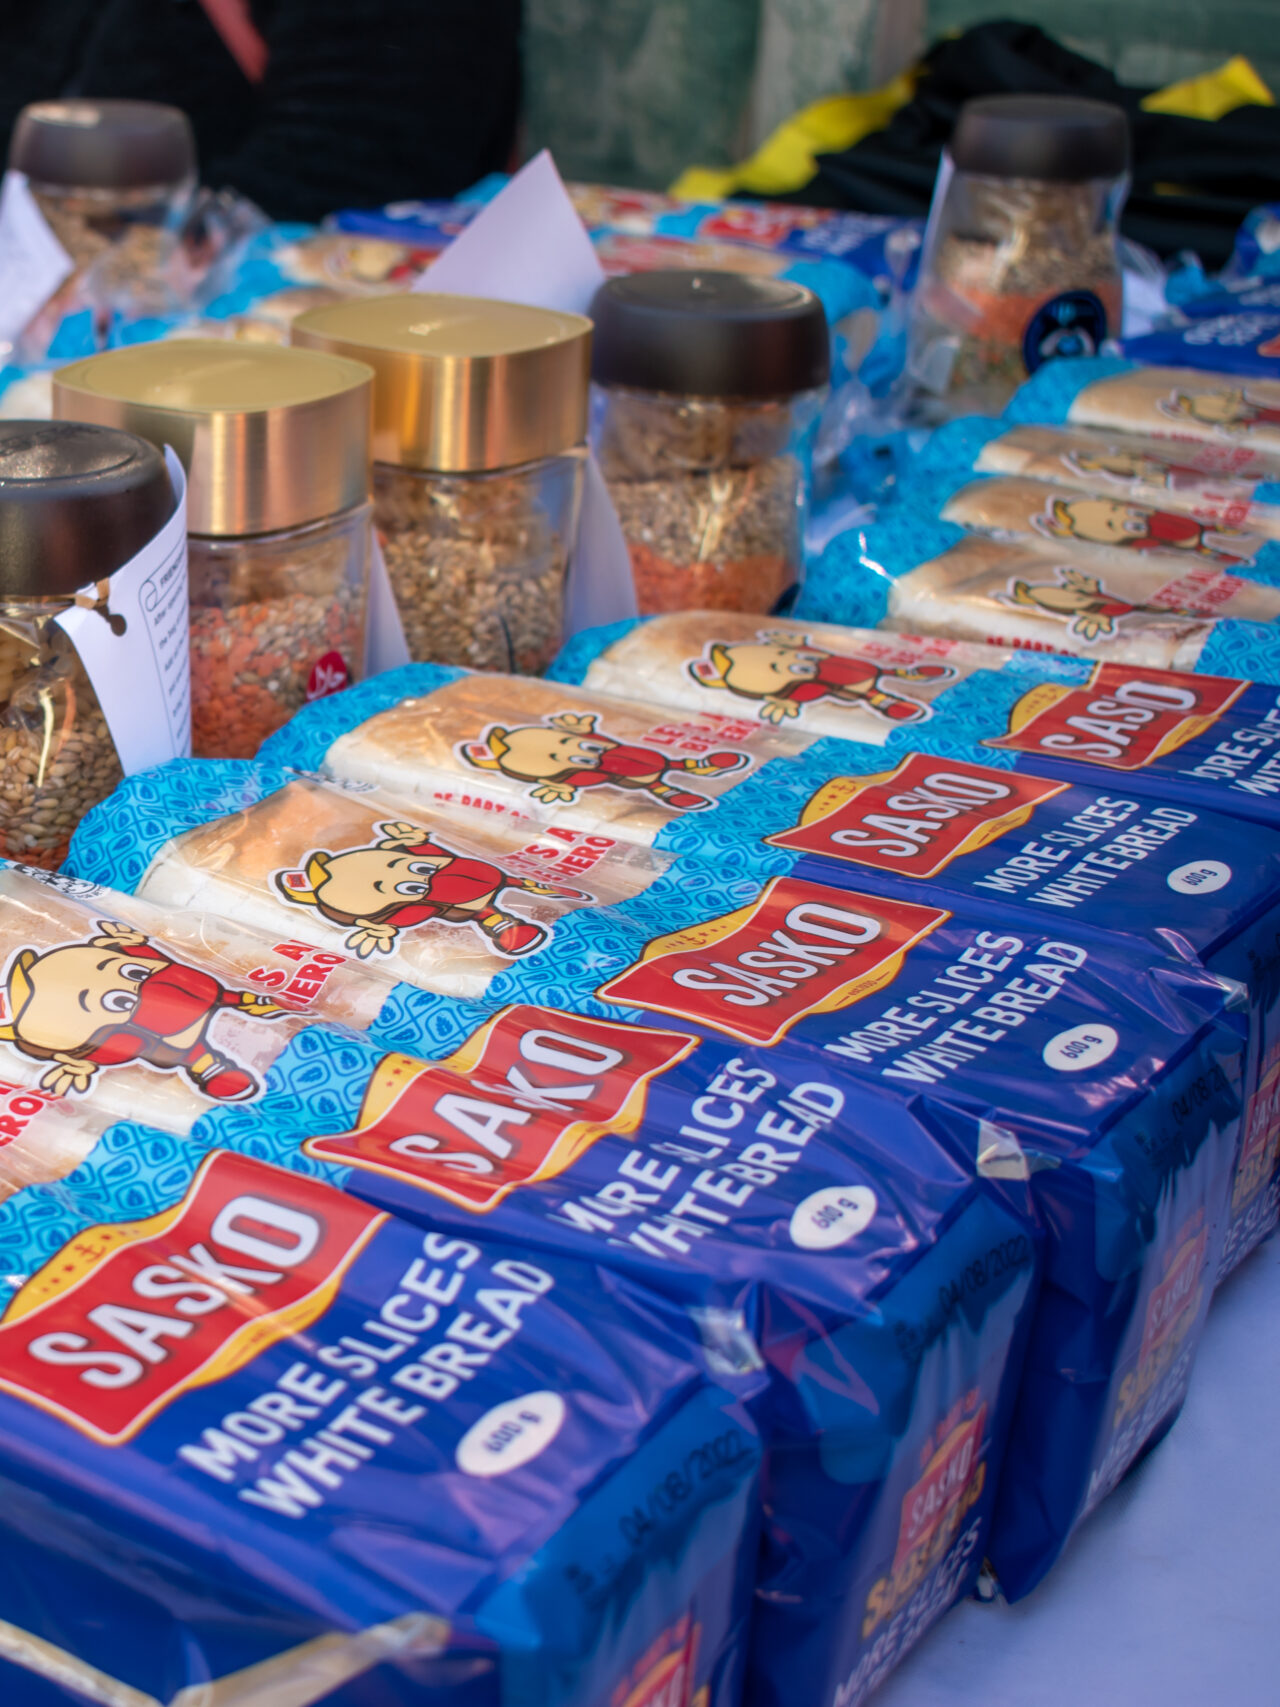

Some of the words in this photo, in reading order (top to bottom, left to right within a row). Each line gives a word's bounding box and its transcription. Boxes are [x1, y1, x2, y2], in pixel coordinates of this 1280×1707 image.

[830, 772, 1010, 857] SASKO
[972, 841, 1071, 894] MORE
[1052, 797, 1139, 847] SLICES
[1026, 846, 1132, 908] WHITE
[1118, 807, 1197, 863] BREAD
[672, 902, 881, 1006] SASKO
[823, 1005, 937, 1063] MORE
[918, 930, 1024, 1014] SLICES
[881, 1013, 1005, 1084] WHITE
[983, 941, 1088, 1028] BREAD
[1059, 1039, 1087, 1060] 600
[1088, 1034, 1104, 1049] g
[719, 1081, 845, 1189] BREAD
[28, 1194, 320, 1388] SASKO
[177, 1360, 347, 1483] MORE
[318, 1232, 480, 1380] SLICES
[238, 1386, 428, 1519] WHITE
[391, 1258, 556, 1401] BREAD
